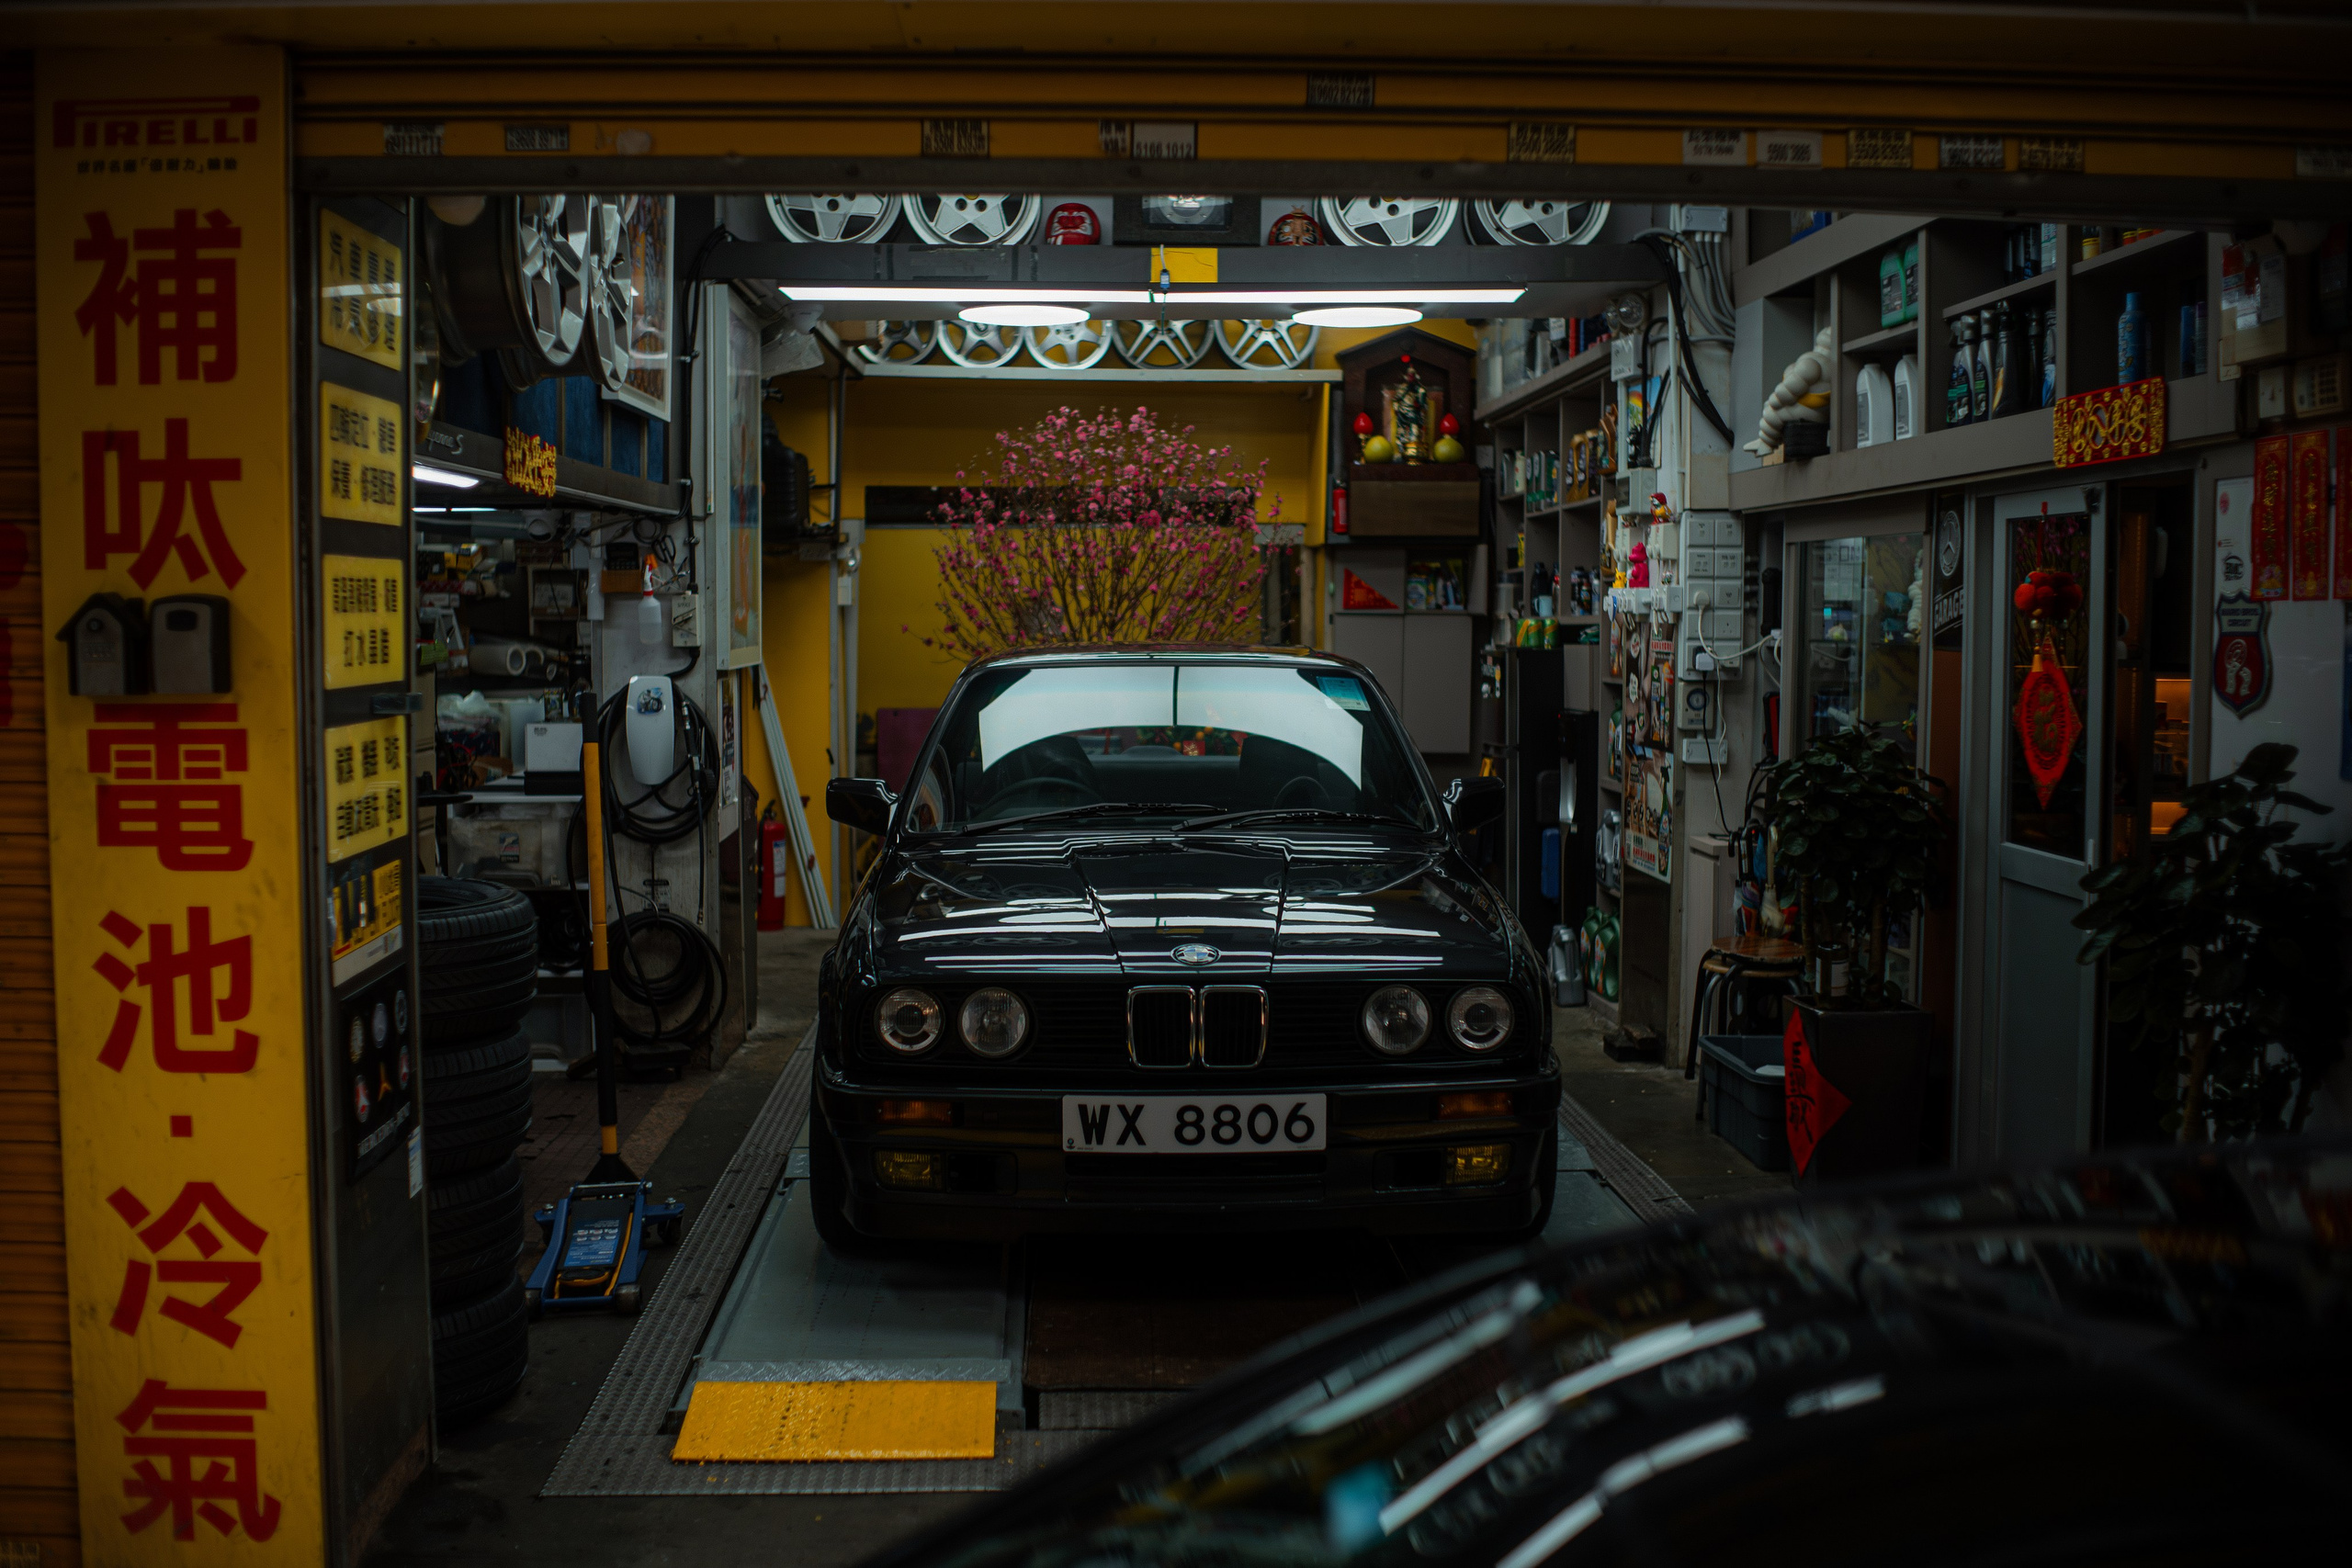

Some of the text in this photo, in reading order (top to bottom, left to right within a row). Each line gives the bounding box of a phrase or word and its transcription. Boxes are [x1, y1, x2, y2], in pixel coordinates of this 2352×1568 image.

[53, 96, 260, 148] PIRELLI
[1078, 1102, 1316, 1145] WX 8806
